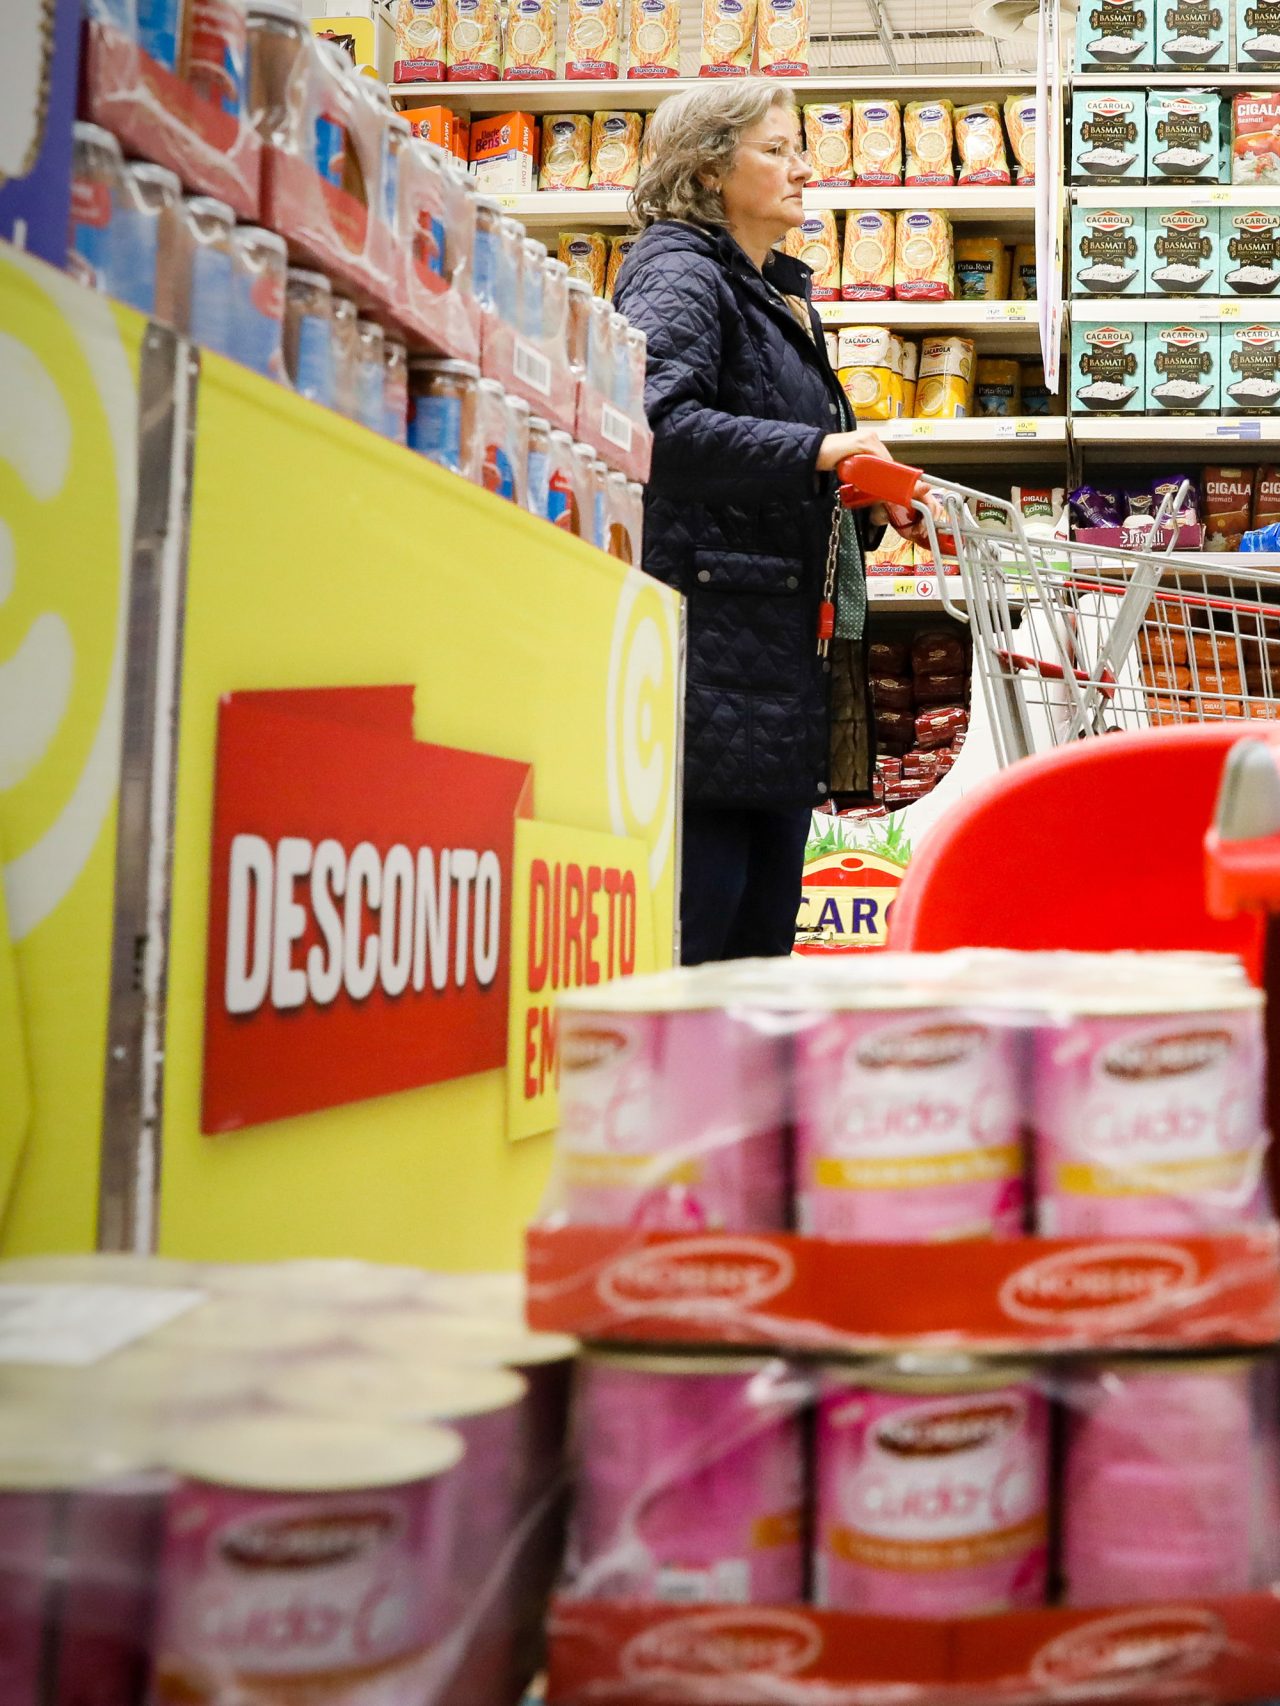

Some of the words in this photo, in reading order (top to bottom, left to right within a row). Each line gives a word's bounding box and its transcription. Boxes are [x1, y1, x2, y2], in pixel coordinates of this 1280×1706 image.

[1099, 14, 1134, 22] BASMATI
[1175, 14, 1210, 22] BASMATI
[481, 126, 500, 140] Uncle
[1090, 126, 1126, 134] BASMATI
[1165, 126, 1201, 134] BASMATI
[1089, 242, 1126, 250] BASMATI
[1164, 242, 1201, 250] BASMATI
[1237, 243, 1274, 251] BASMATI
[1089, 359, 1126, 367] BASMATI
[1164, 358, 1200, 366] BASMATI
[1239, 356, 1276, 365] BASMATI
[1206, 481, 1251, 496] CIGALA
[225, 834, 502, 1015] DESCONTO
[527, 858, 637, 993] DIRETO
